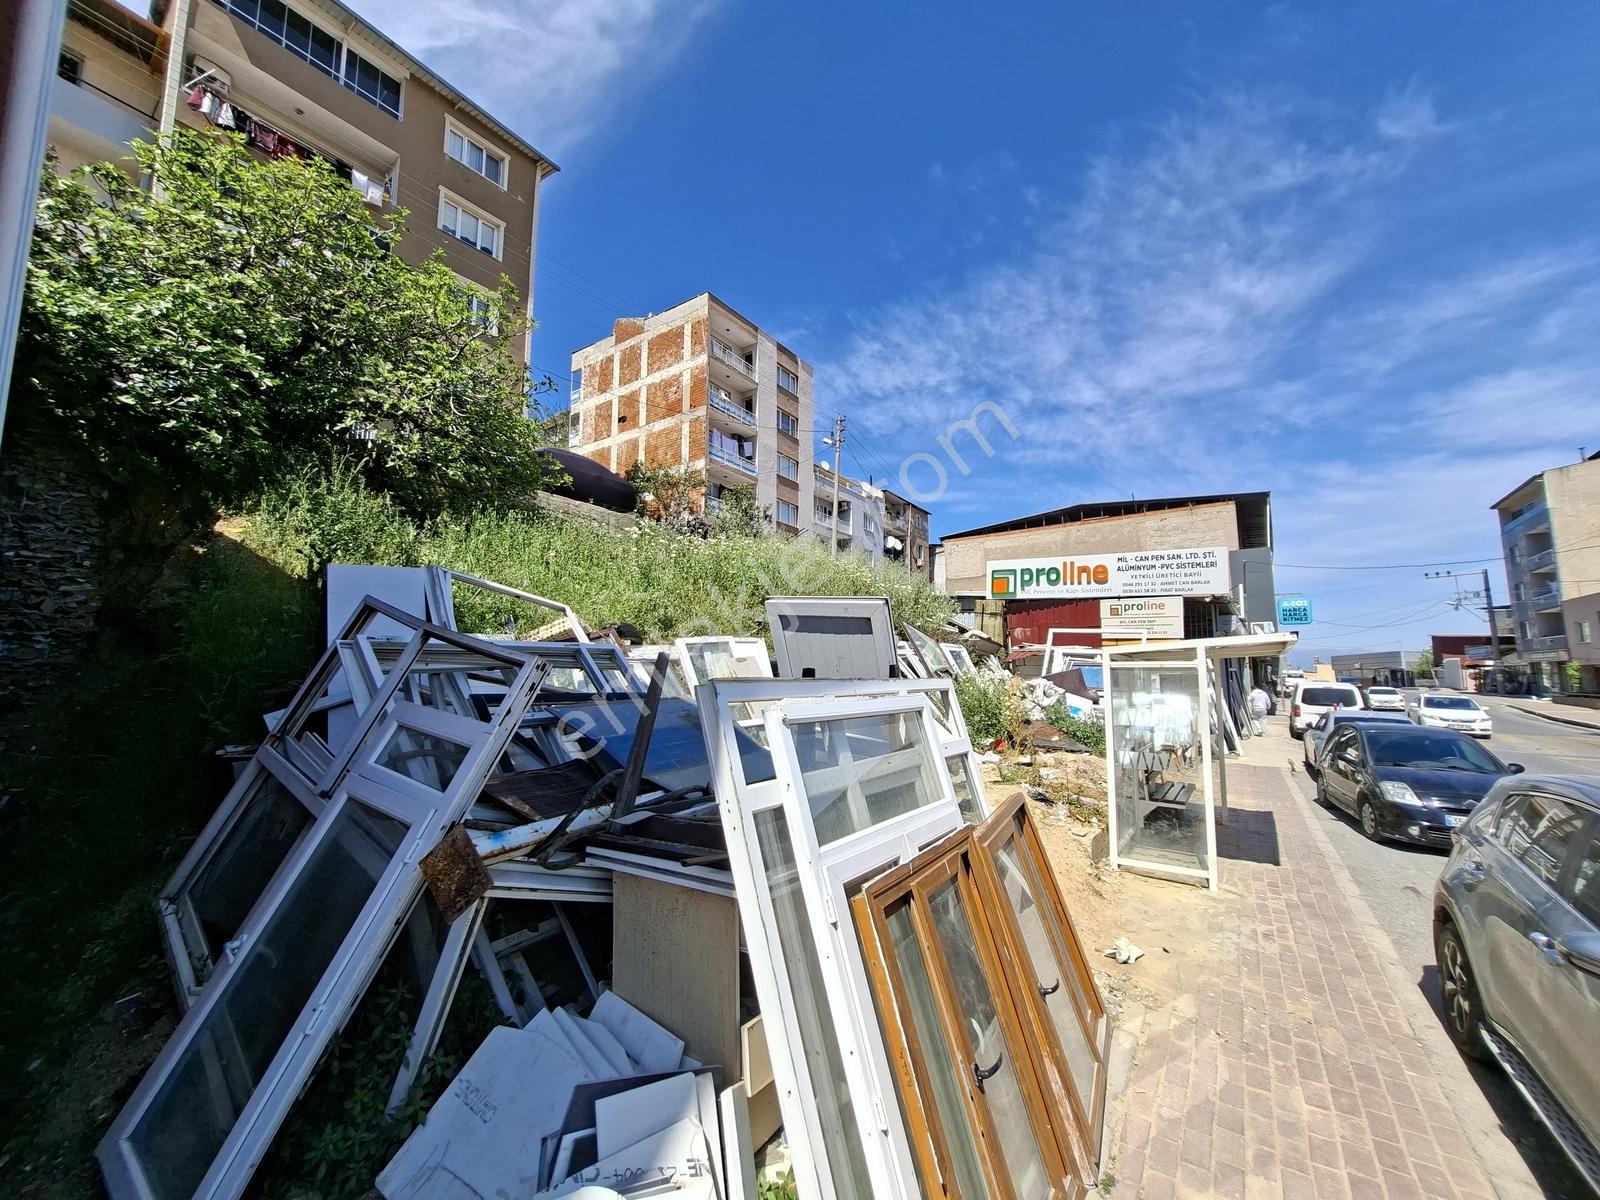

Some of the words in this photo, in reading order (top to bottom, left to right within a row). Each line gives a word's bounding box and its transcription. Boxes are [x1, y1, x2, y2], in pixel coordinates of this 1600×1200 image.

[1117, 555, 1128, 563] MİL
[1203, 550, 1216, 560] ŞTİ.
[1116, 564, 1156, 572] ALÜMİNYUM
[1176, 560, 1218, 570] SİSTEMLERİ
[1020, 561, 1109, 591] proline
[1124, 600, 1166, 612] proline
